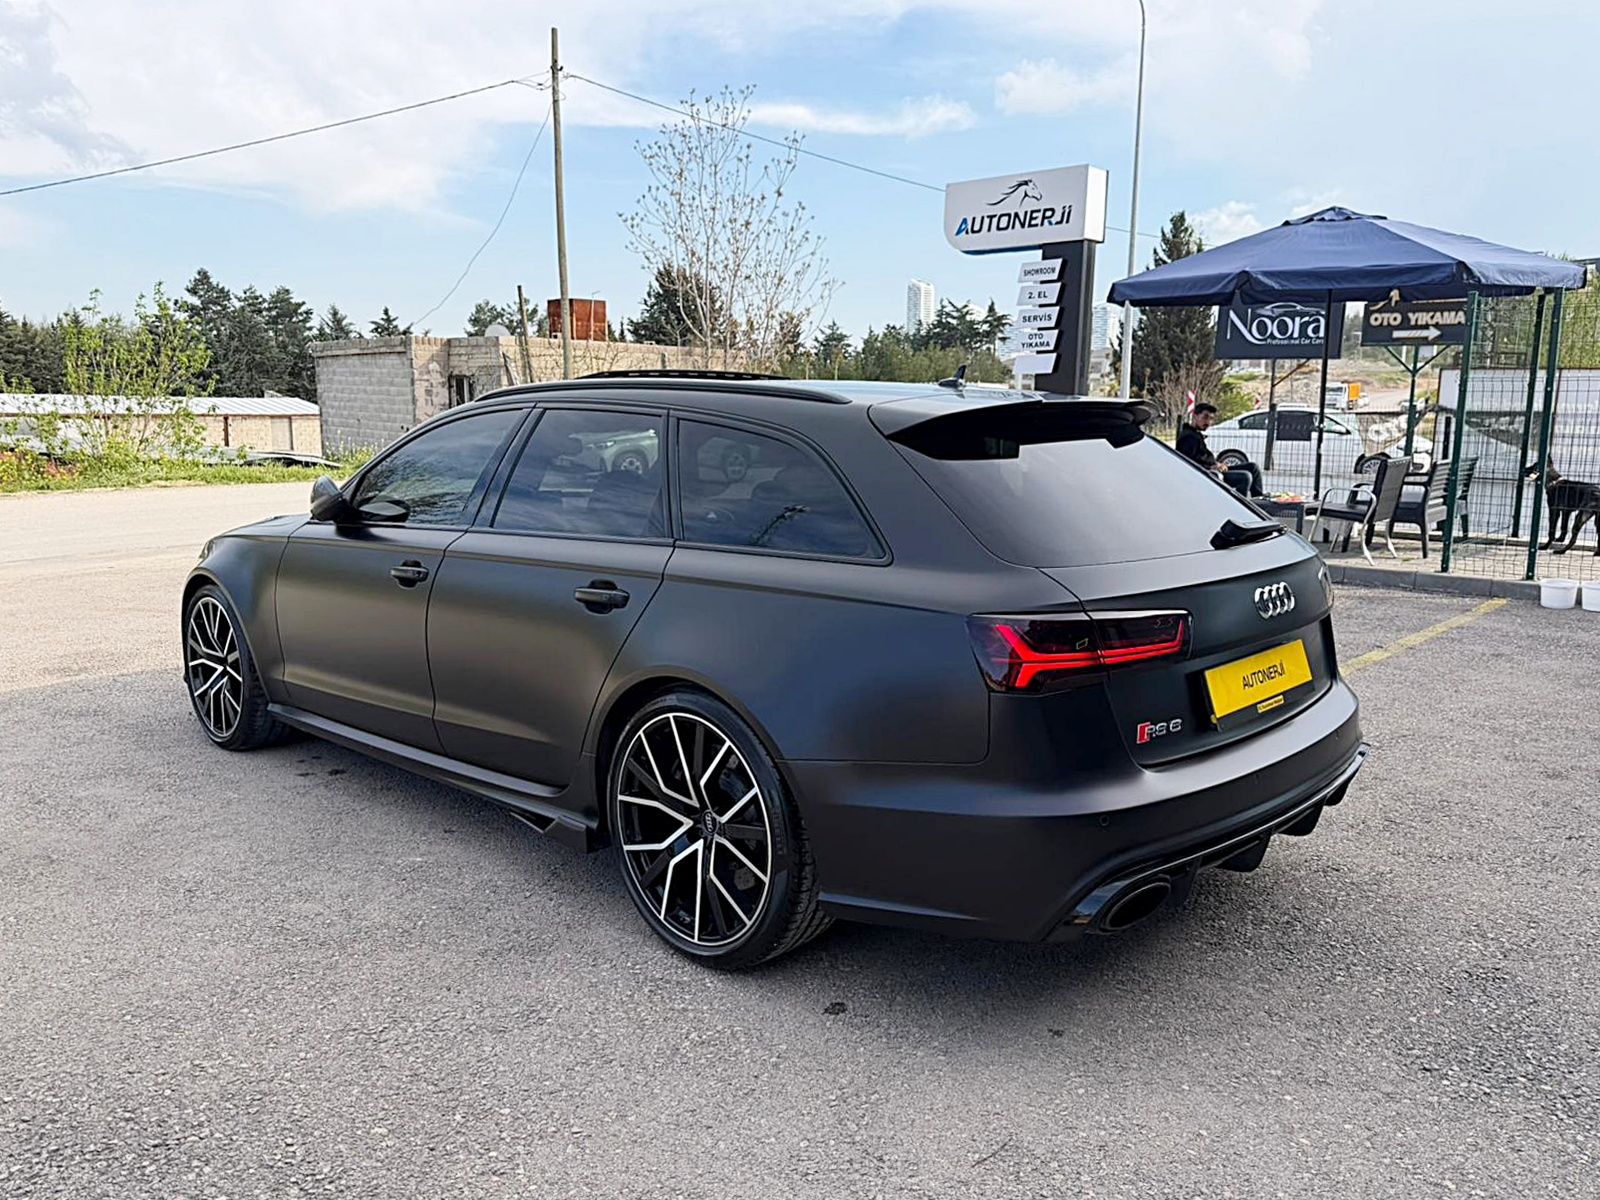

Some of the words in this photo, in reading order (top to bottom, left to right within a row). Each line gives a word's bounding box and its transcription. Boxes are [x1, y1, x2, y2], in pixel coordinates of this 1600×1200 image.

[1023, 266, 1057, 277] SHOWROOM
[1037, 291, 1048, 299] EL
[1022, 313, 1052, 323] SERVİS
[1369, 312, 1402, 327] OTO
[1407, 310, 1466, 326] YIKAMA
[1226, 309, 1325, 344] Noora
[1028, 333, 1044, 341] OTO
